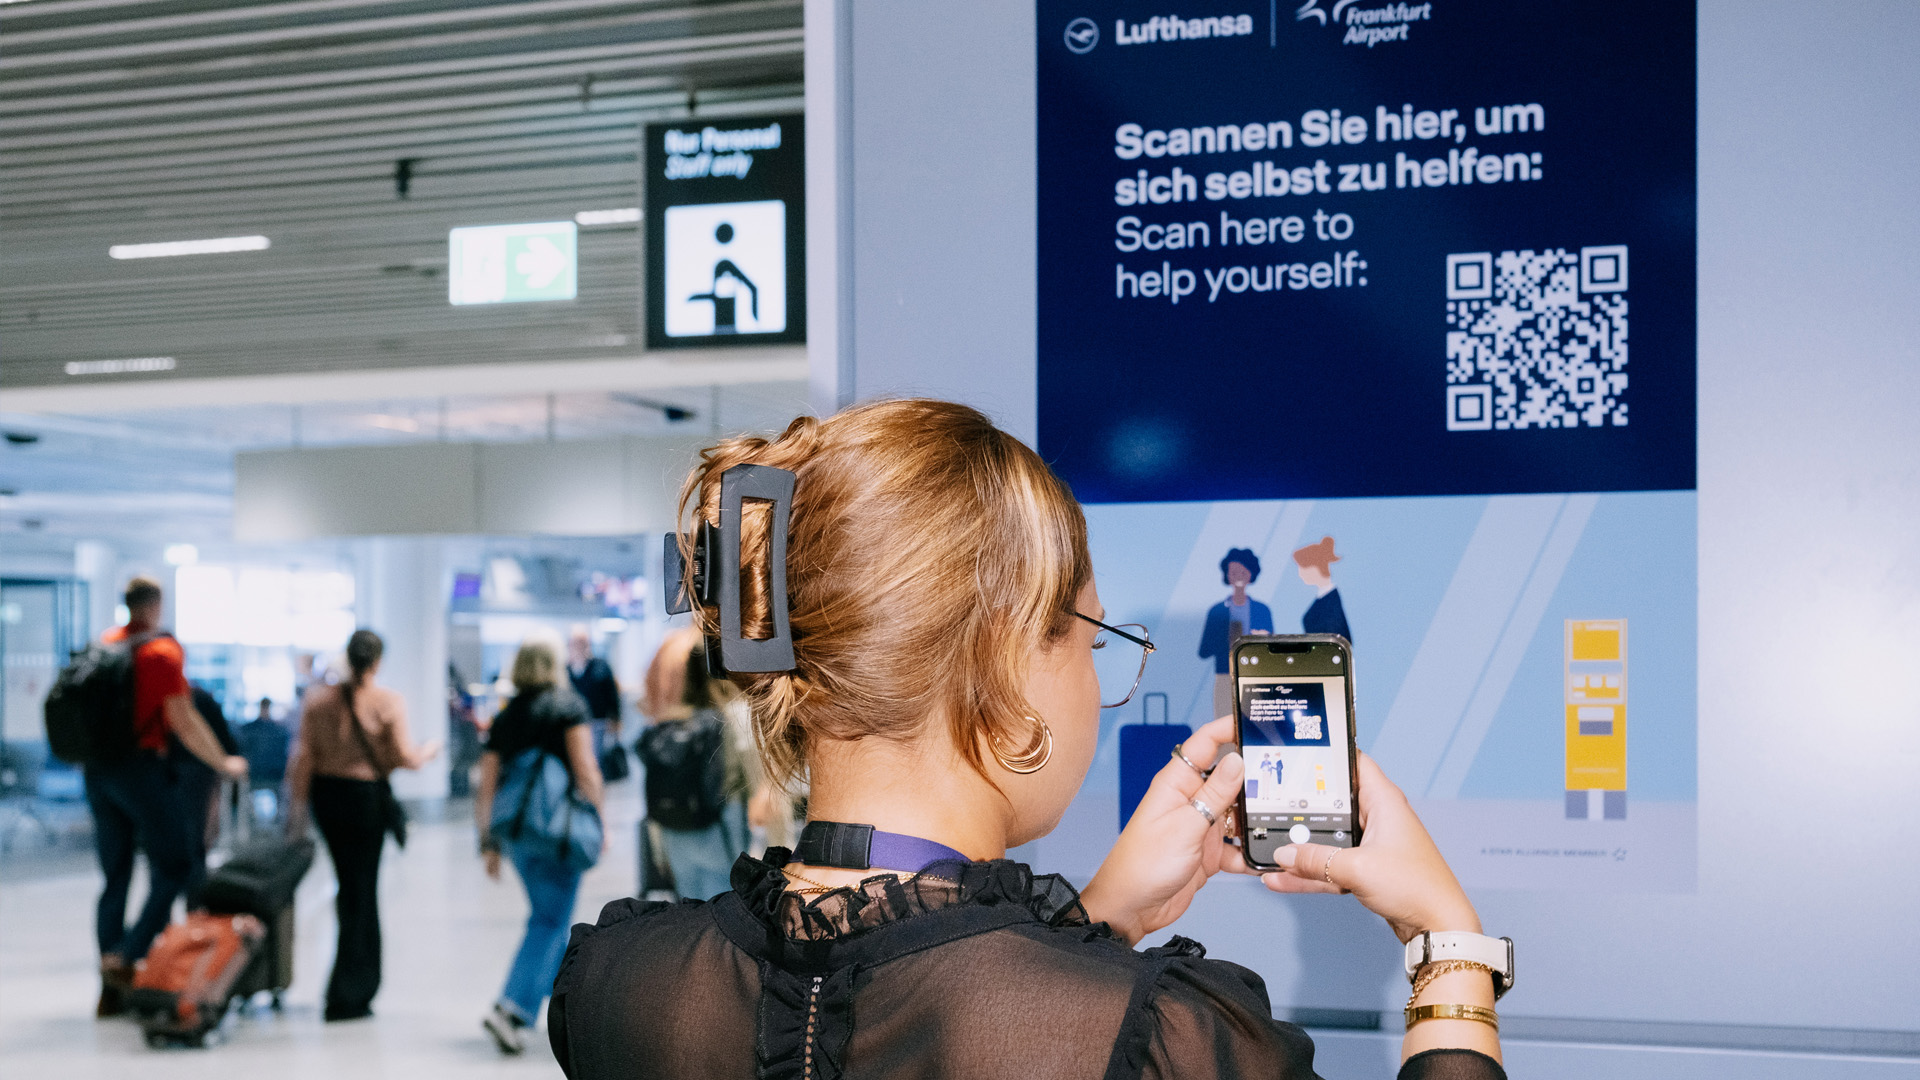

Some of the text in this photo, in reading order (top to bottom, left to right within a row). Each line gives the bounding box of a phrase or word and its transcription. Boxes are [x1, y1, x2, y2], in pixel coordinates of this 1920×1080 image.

[1115, 14, 1253, 45] Lufthansa
[1342, 23, 1409, 48] Airport
[1346, 2, 1432, 25] Frankfurt
[1115, 103, 1545, 159] Scannen Sie hier, um
[1115, 147, 1543, 205] sich selbst zu helfen:
[1115, 208, 1354, 252] Scan here to
[1115, 251, 1368, 304] help yourself:
